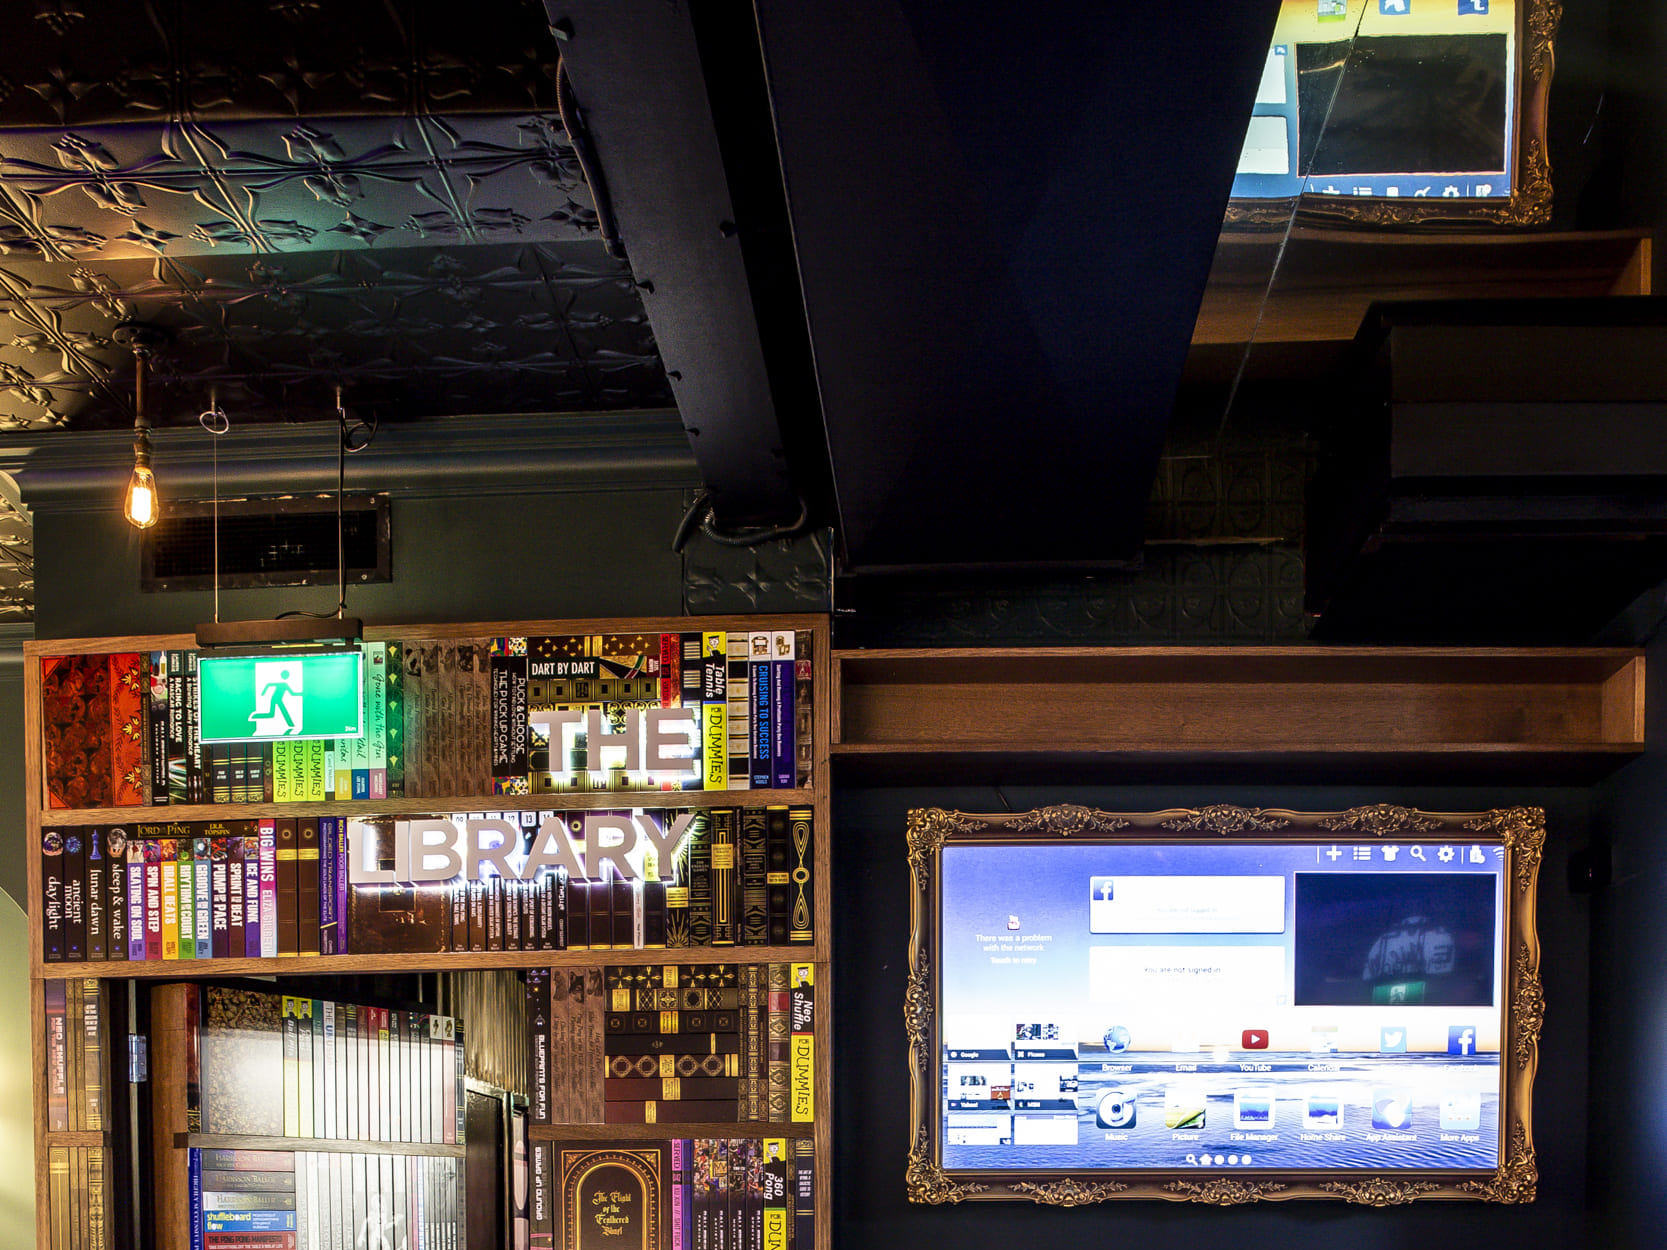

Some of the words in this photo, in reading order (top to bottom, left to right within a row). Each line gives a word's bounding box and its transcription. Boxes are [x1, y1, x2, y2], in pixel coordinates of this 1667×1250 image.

[531, 662, 555, 676] DART
[557, 662, 569, 675] BY
[571, 661, 595, 674] DART
[705, 663, 716, 698] Tennis
[715, 665, 726, 695] Table
[174, 677, 182, 708] RACING
[759, 665, 769, 706] CRUISING
[174, 710, 182, 720] TO
[759, 708, 769, 719] TO
[174, 722, 183, 744] LOVE
[530, 708, 693, 773] THE
[759, 721, 770, 760] SUCCESS
[708, 714, 724, 784] DUMMIES
[275, 746, 287, 798] DUMMIES
[293, 745, 305, 797] DUMMIES
[311, 745, 322, 797] DUMMIES
[260, 827, 274, 847] BIG
[349, 813, 697, 884] LIBRARY
[108, 864, 124, 894] sleep
[147, 866, 159, 887] SPIN
[247, 862, 258, 877] ICE
[261, 850, 274, 882] WINS
[90, 869, 102, 900] lunar
[130, 867, 142, 904] SKATING
[147, 889, 159, 908] AND
[247, 879, 258, 898] AND
[46, 876, 62, 930] daylight
[65, 885, 74, 919] moon
[73, 880, 84, 924] ancient
[113, 896, 124, 906] &
[130, 905, 142, 918] ON
[247, 900, 259, 923] FUNK
[91, 902, 103, 935] dawn
[113, 909, 125, 940] wake
[131, 920, 143, 942] SOUL
[148, 911, 160, 932] STEP
[976, 934, 997, 942] There
[1022, 934, 1052, 944] problem
[794, 992, 804, 1030] Shuffle
[803, 1000, 814, 1022] Neo
[795, 1046, 811, 1115] DUMMIES
[1102, 1063, 1132, 1072] Browser
[1240, 1063, 1272, 1072] YouTube
[763, 1172, 775, 1200] Pong
[774, 1176, 784, 1196] 360
